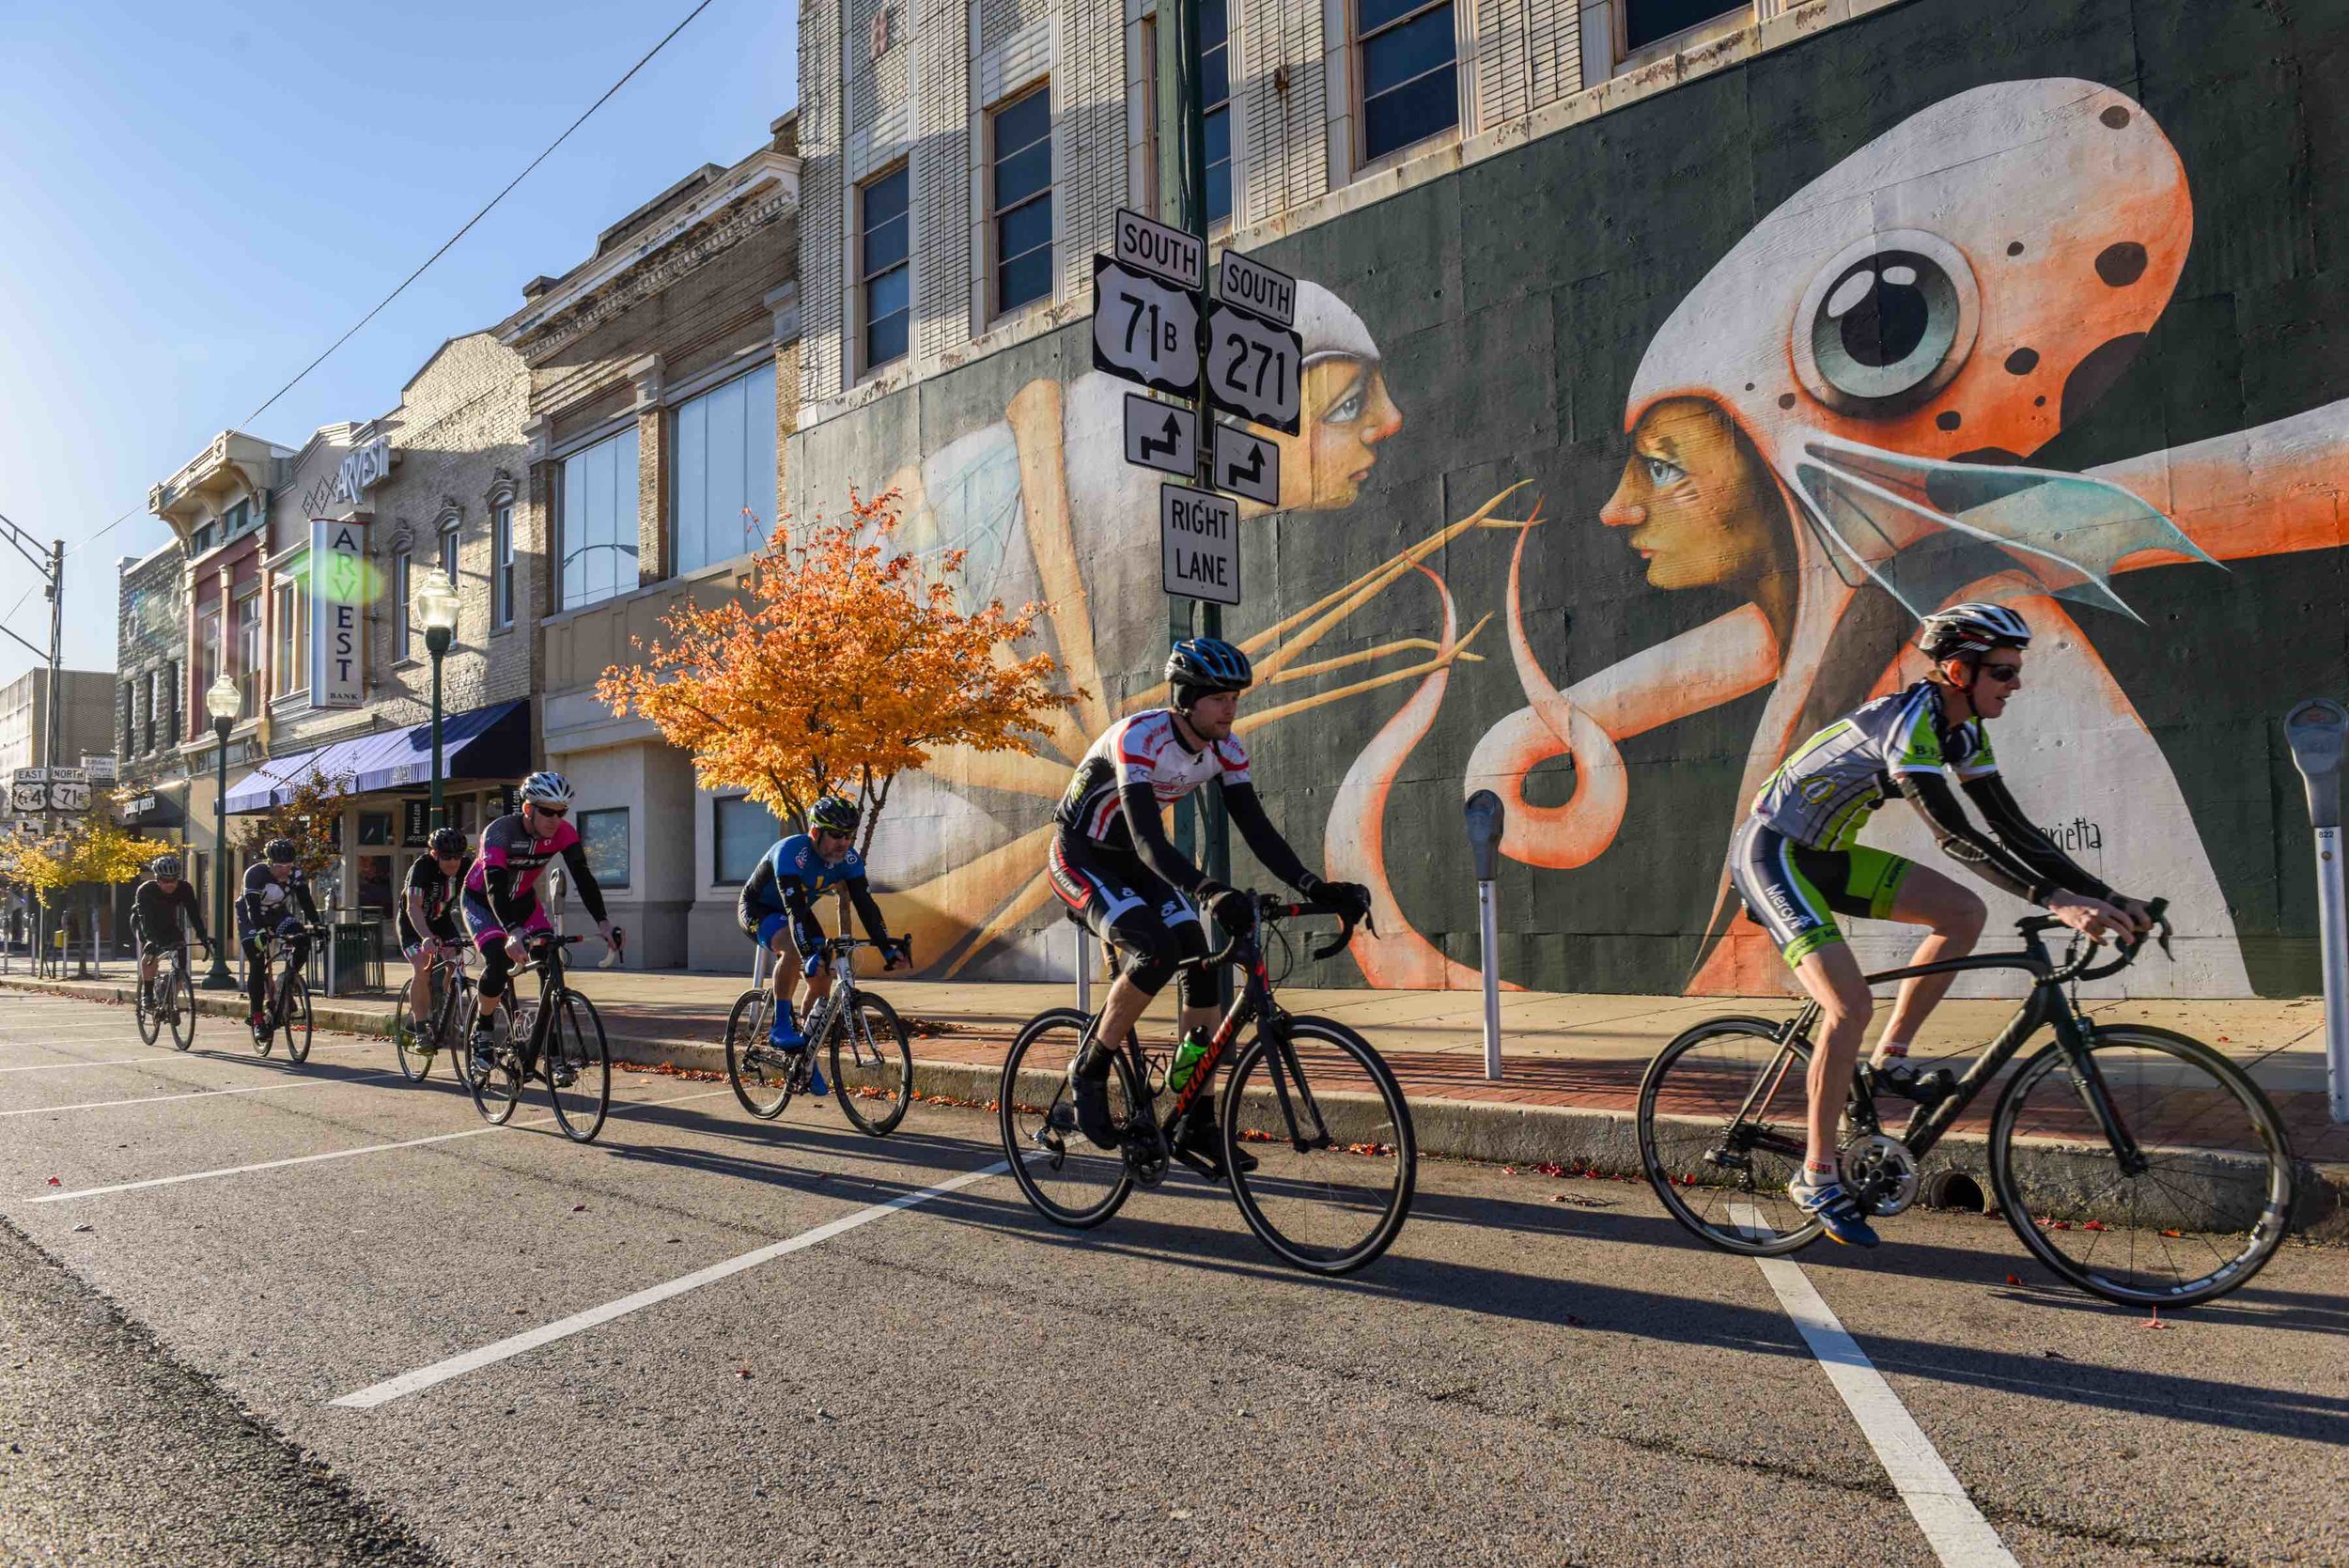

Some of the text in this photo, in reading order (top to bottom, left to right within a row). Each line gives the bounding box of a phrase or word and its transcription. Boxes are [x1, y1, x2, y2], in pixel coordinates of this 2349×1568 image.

[1124, 224, 1196, 276] SOUTH
[1228, 264, 1290, 315] SOUTH
[1226, 334, 1285, 406] 271
[335, 438, 389, 505] ARVEST
[1172, 499, 1229, 539] RIGHT
[1176, 548, 1228, 586] LANE
[333, 527, 358, 682] ARVEST
[19, 770, 42, 779] EAST
[54, 769, 83, 778] NORTH
[18, 789, 41, 805] 64
[1765, 883, 1797, 922] Mercy
